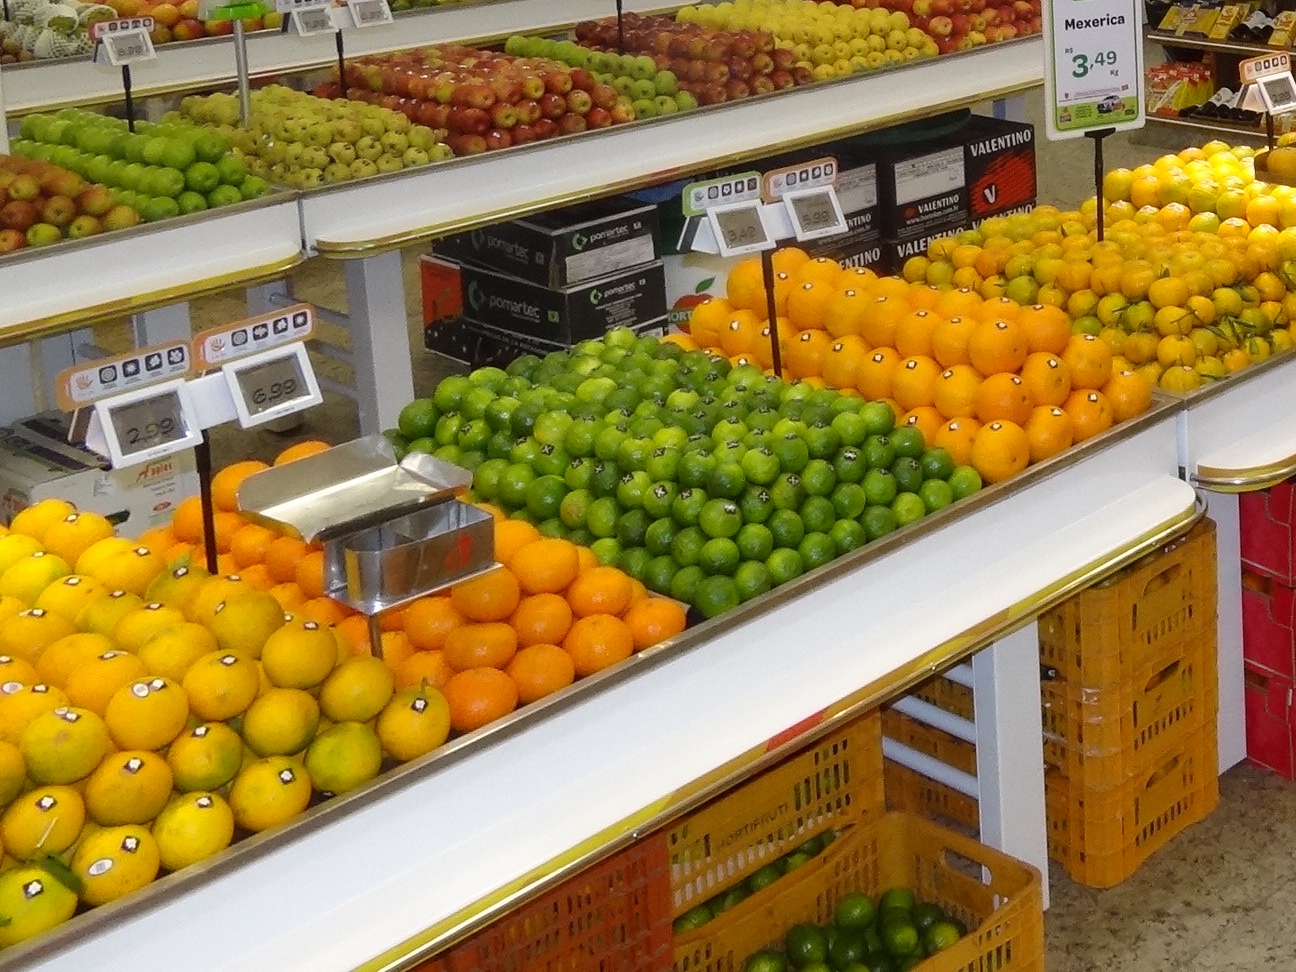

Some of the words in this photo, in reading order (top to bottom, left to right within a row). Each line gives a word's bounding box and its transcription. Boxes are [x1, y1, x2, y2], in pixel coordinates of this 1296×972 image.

[1064, 13, 1126, 31] Mexerica
[1072, 50, 1118, 78] 3,49
[970, 129, 1033, 158] VALENTINO
[918, 194, 960, 214] VALENTINO
[983, 184, 996, 204] V
[848, 213, 872, 228] NTINO
[589, 223, 629, 242] pomartec
[487, 234, 530, 260] pomartec
[839, 247, 881, 270] ENTINO
[603, 281, 637, 299] pomartec
[488, 294, 540, 319] pomartec
